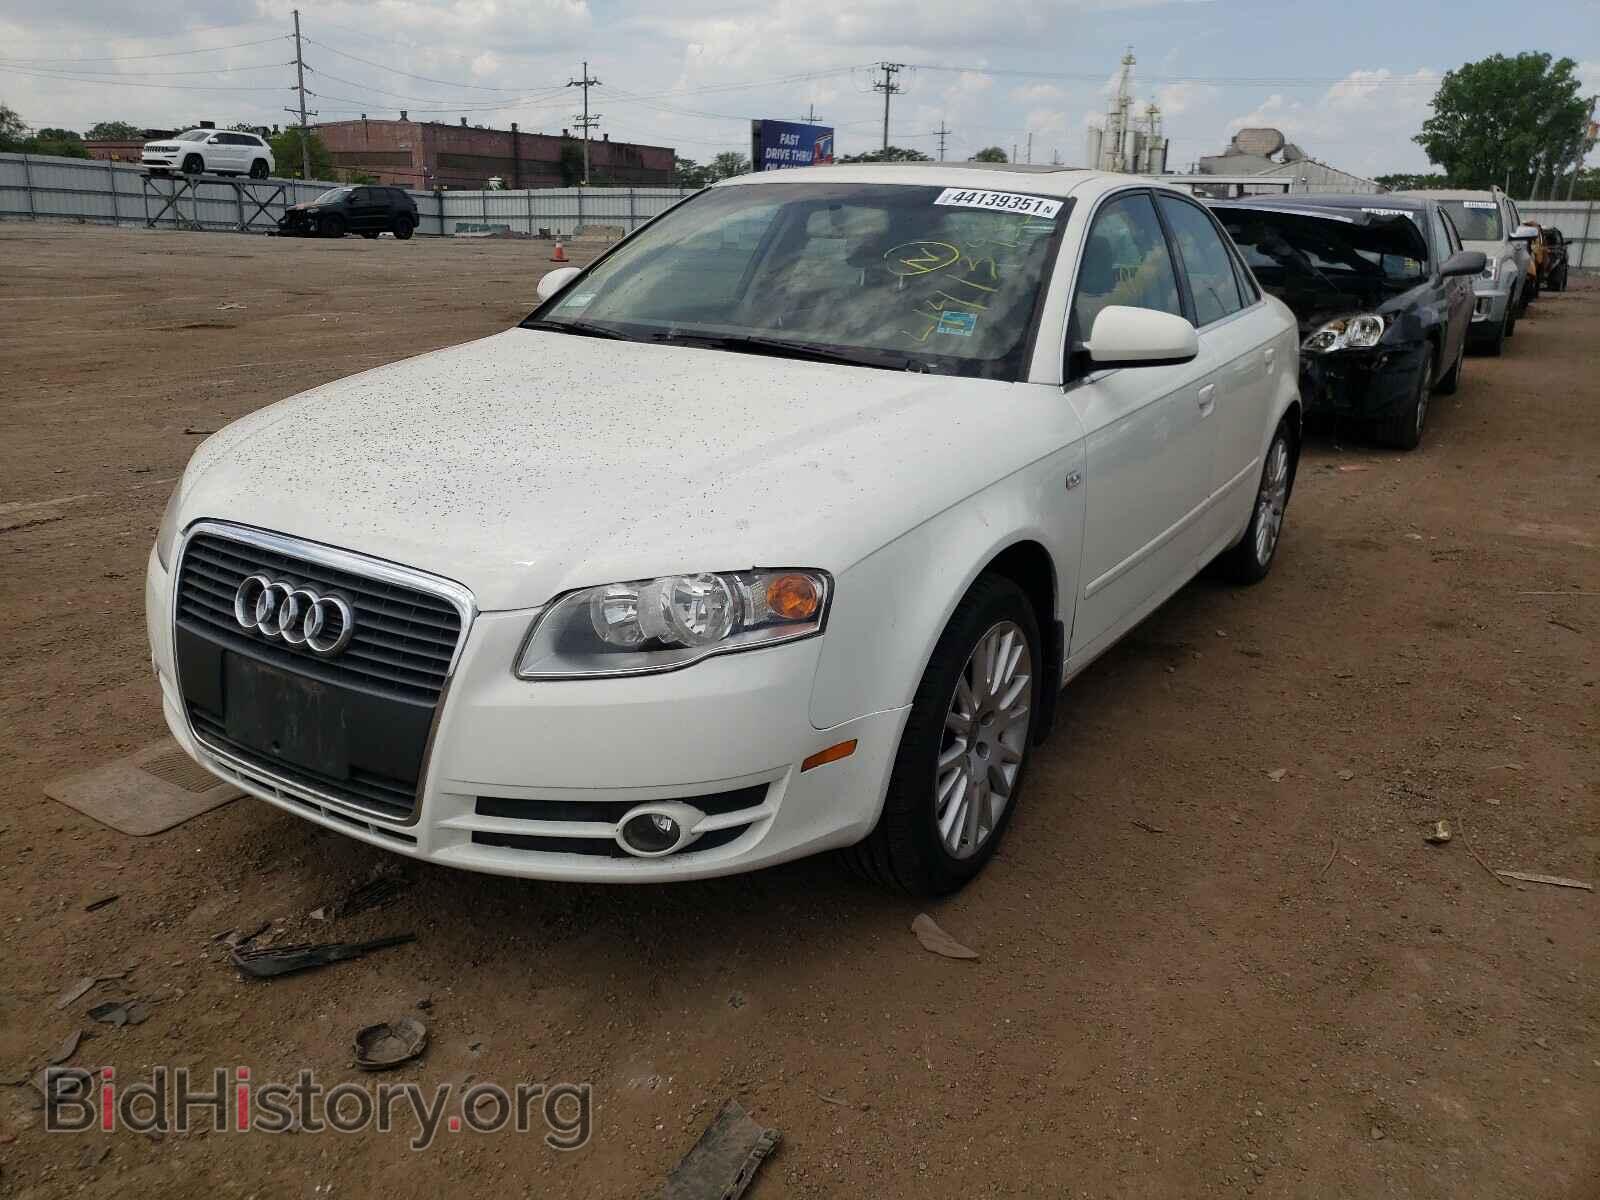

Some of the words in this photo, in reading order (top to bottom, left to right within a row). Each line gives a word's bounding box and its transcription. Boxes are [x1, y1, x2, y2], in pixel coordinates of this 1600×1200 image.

[780, 133, 800, 145] FAST
[765, 147, 790, 160] DRIVE
[791, 149, 812, 161] THRU
[953, 191, 1043, 213] 44139351
